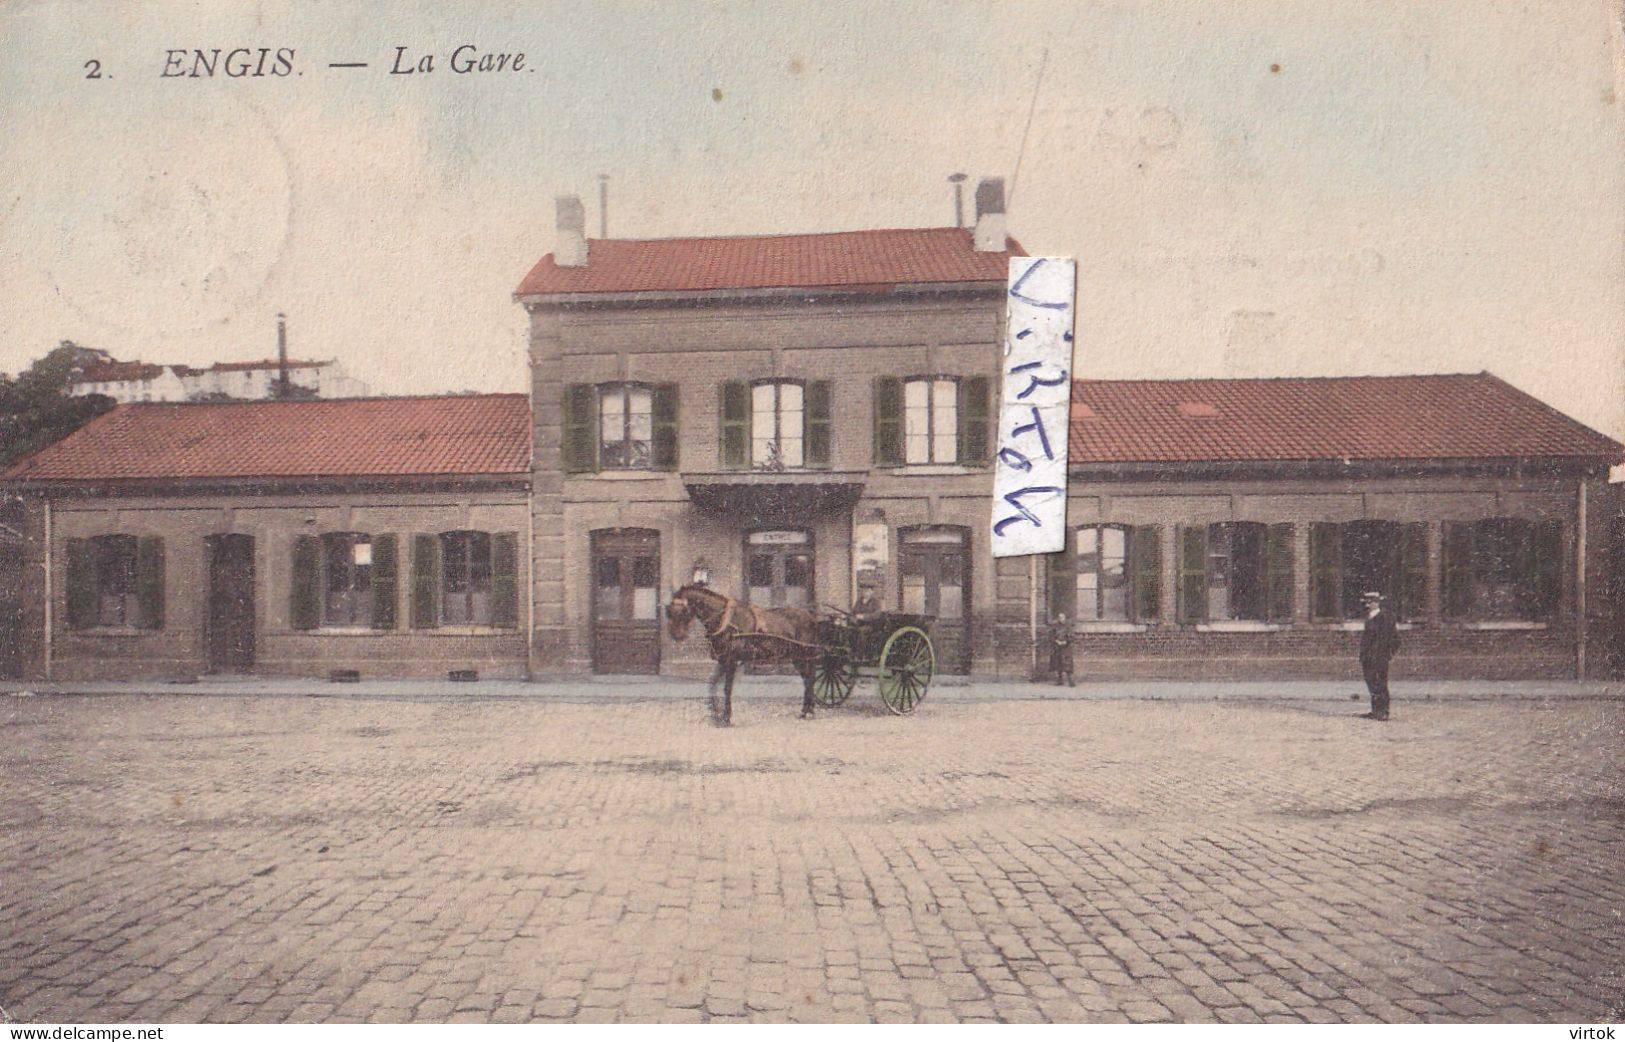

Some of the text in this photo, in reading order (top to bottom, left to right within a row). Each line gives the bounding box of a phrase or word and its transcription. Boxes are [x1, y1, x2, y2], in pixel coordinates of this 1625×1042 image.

[84, 59, 113, 79] 2.
[161, 47, 303, 78] ENGIS.
[389, 46, 435, 75] La
[450, 44, 535, 74] Gare.
